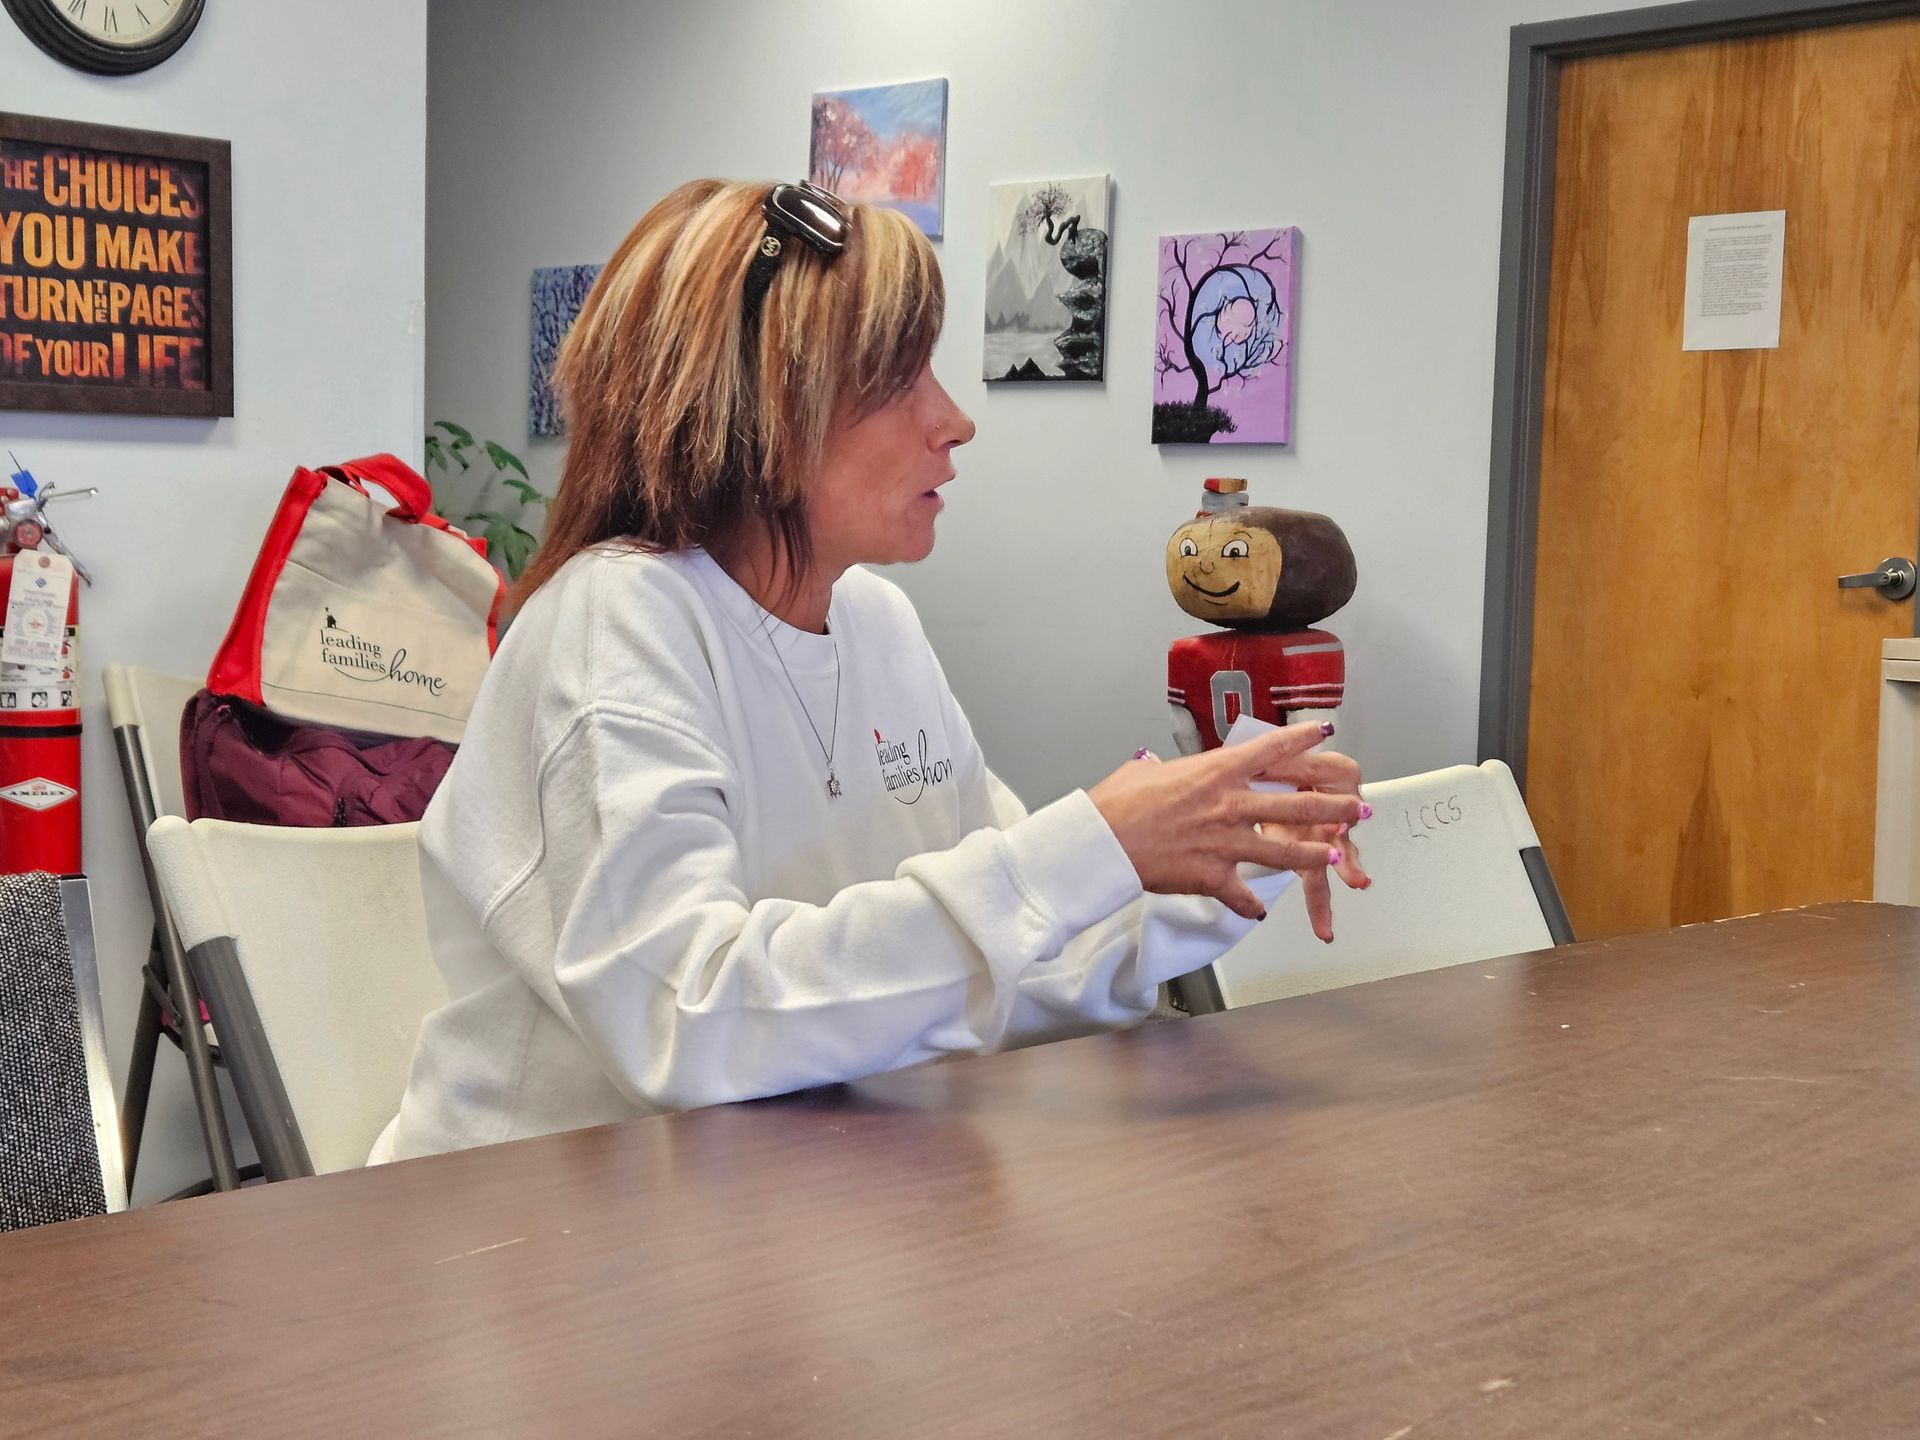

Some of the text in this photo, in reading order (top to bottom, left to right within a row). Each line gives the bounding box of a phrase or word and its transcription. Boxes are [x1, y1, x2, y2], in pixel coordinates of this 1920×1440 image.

[43, 153, 203, 219] CHOICES
[0, 211, 204, 275] YOU MAKE
[92, 279, 108, 323] THE
[109, 281, 205, 329] PAGES
[35, 338, 110, 378] YOUR
[320, 629, 382, 659] leading
[322, 648, 447, 697] families home
[874, 740, 911, 766] leading
[882, 765, 921, 792] families
[1404, 795, 1462, 839] LCCS
